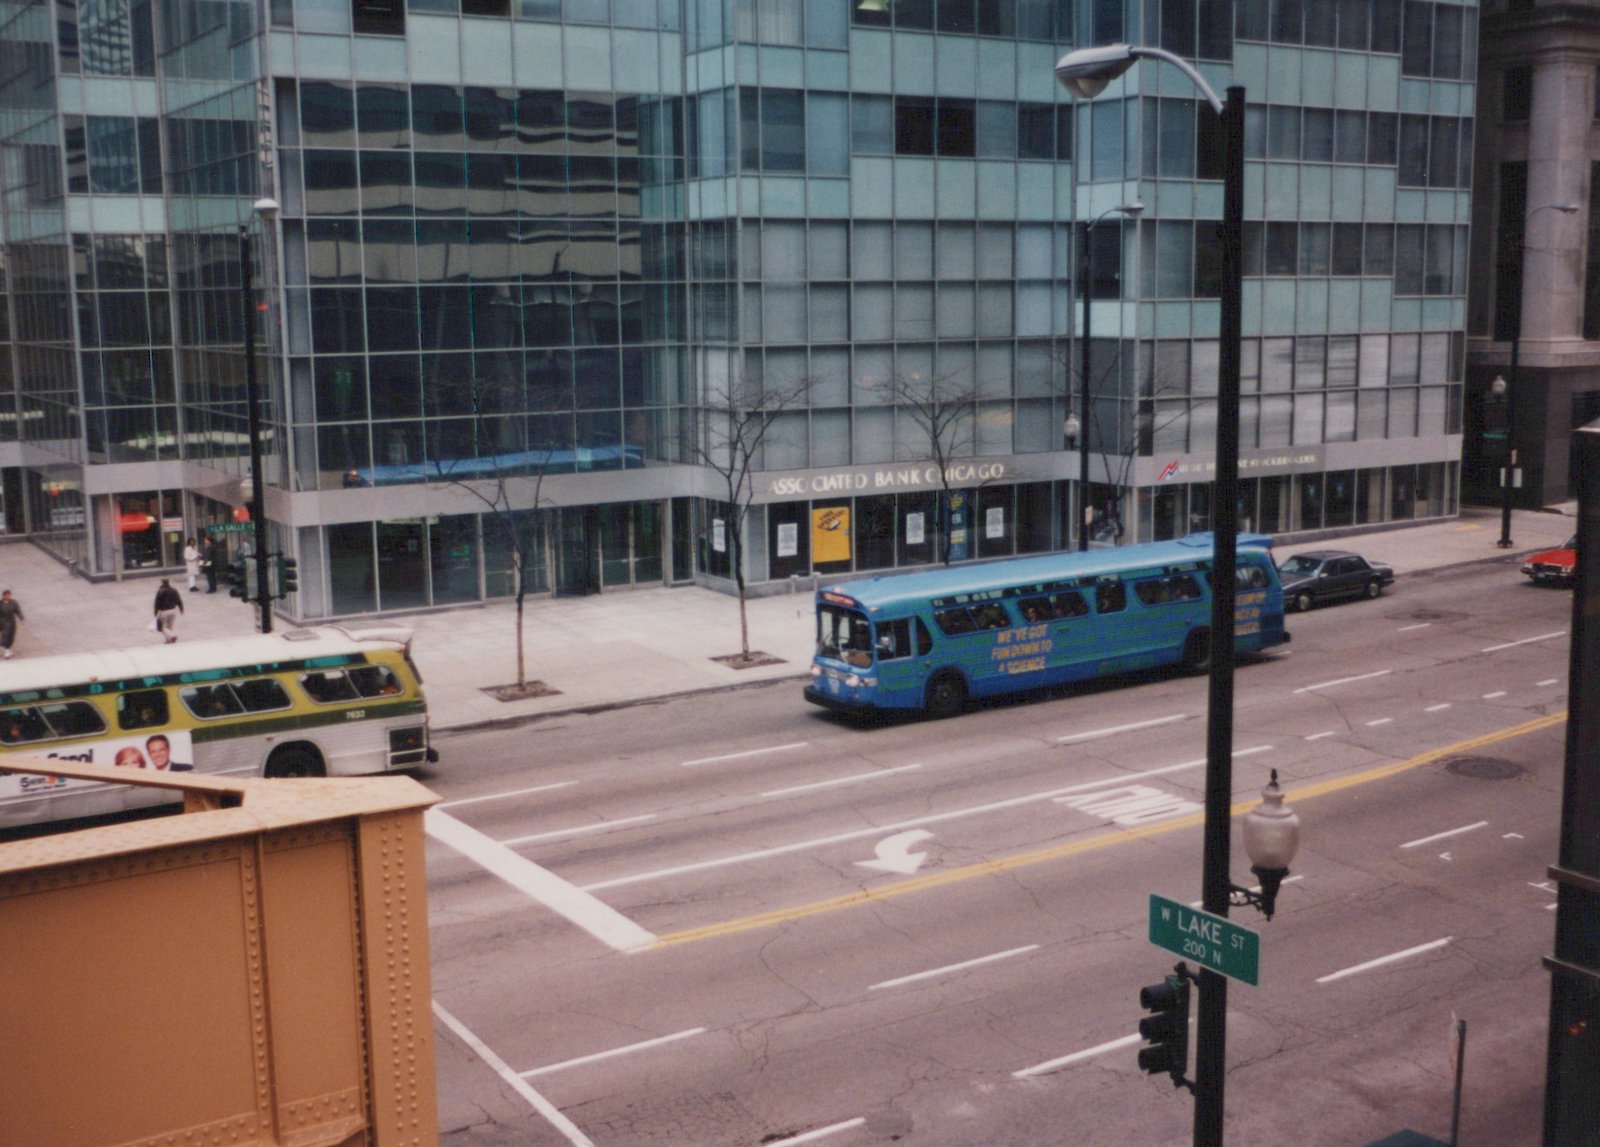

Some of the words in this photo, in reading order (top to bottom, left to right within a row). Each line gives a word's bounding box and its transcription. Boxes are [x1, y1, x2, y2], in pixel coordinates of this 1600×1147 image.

[769, 473, 868, 495] ASSOCIATED
[875, 468, 921, 488] BANK
[925, 463, 1004, 483] CHICAGO
[1028, 624, 1049, 640] GOT
[1161, 906, 1171, 922] W
[1178, 910, 1223, 945] LAKE
[1230, 934, 1246, 950] ST
[1183, 938, 1206, 958] 200
[1212, 951, 1222, 966] N
